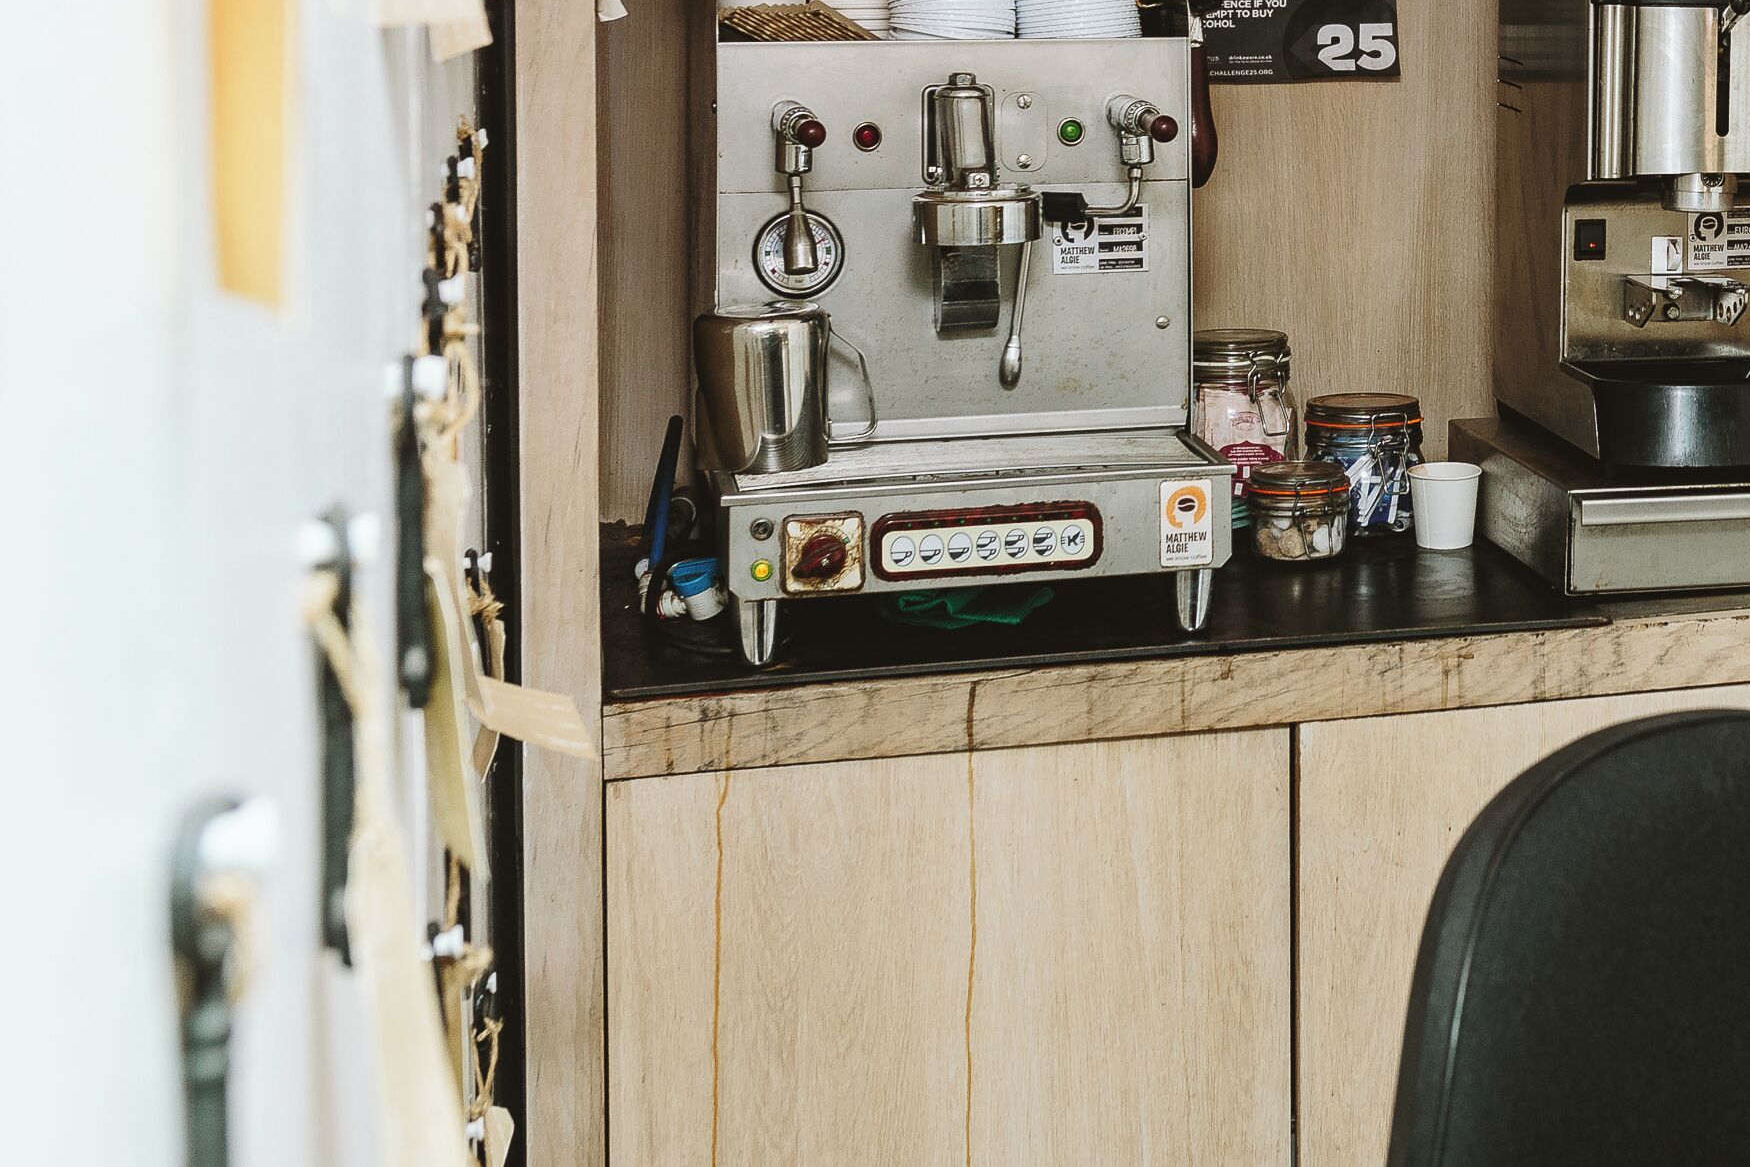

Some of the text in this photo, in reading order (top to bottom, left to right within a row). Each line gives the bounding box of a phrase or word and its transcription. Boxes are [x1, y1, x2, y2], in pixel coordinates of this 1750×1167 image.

[1253, 0, 1287, 8] IF YOU
[1236, 10, 1274, 18] TO BUY
[1316, 22, 1396, 73] 25
[1060, 246, 1095, 256] MATTHEW
[1693, 243, 1725, 253] MATTHEW
[1060, 255, 1080, 265] ALGIE
[1693, 252, 1711, 261] ALGIE
[1165, 531, 1207, 544] MATTHEW
[1166, 542, 1189, 554] ALGIE
